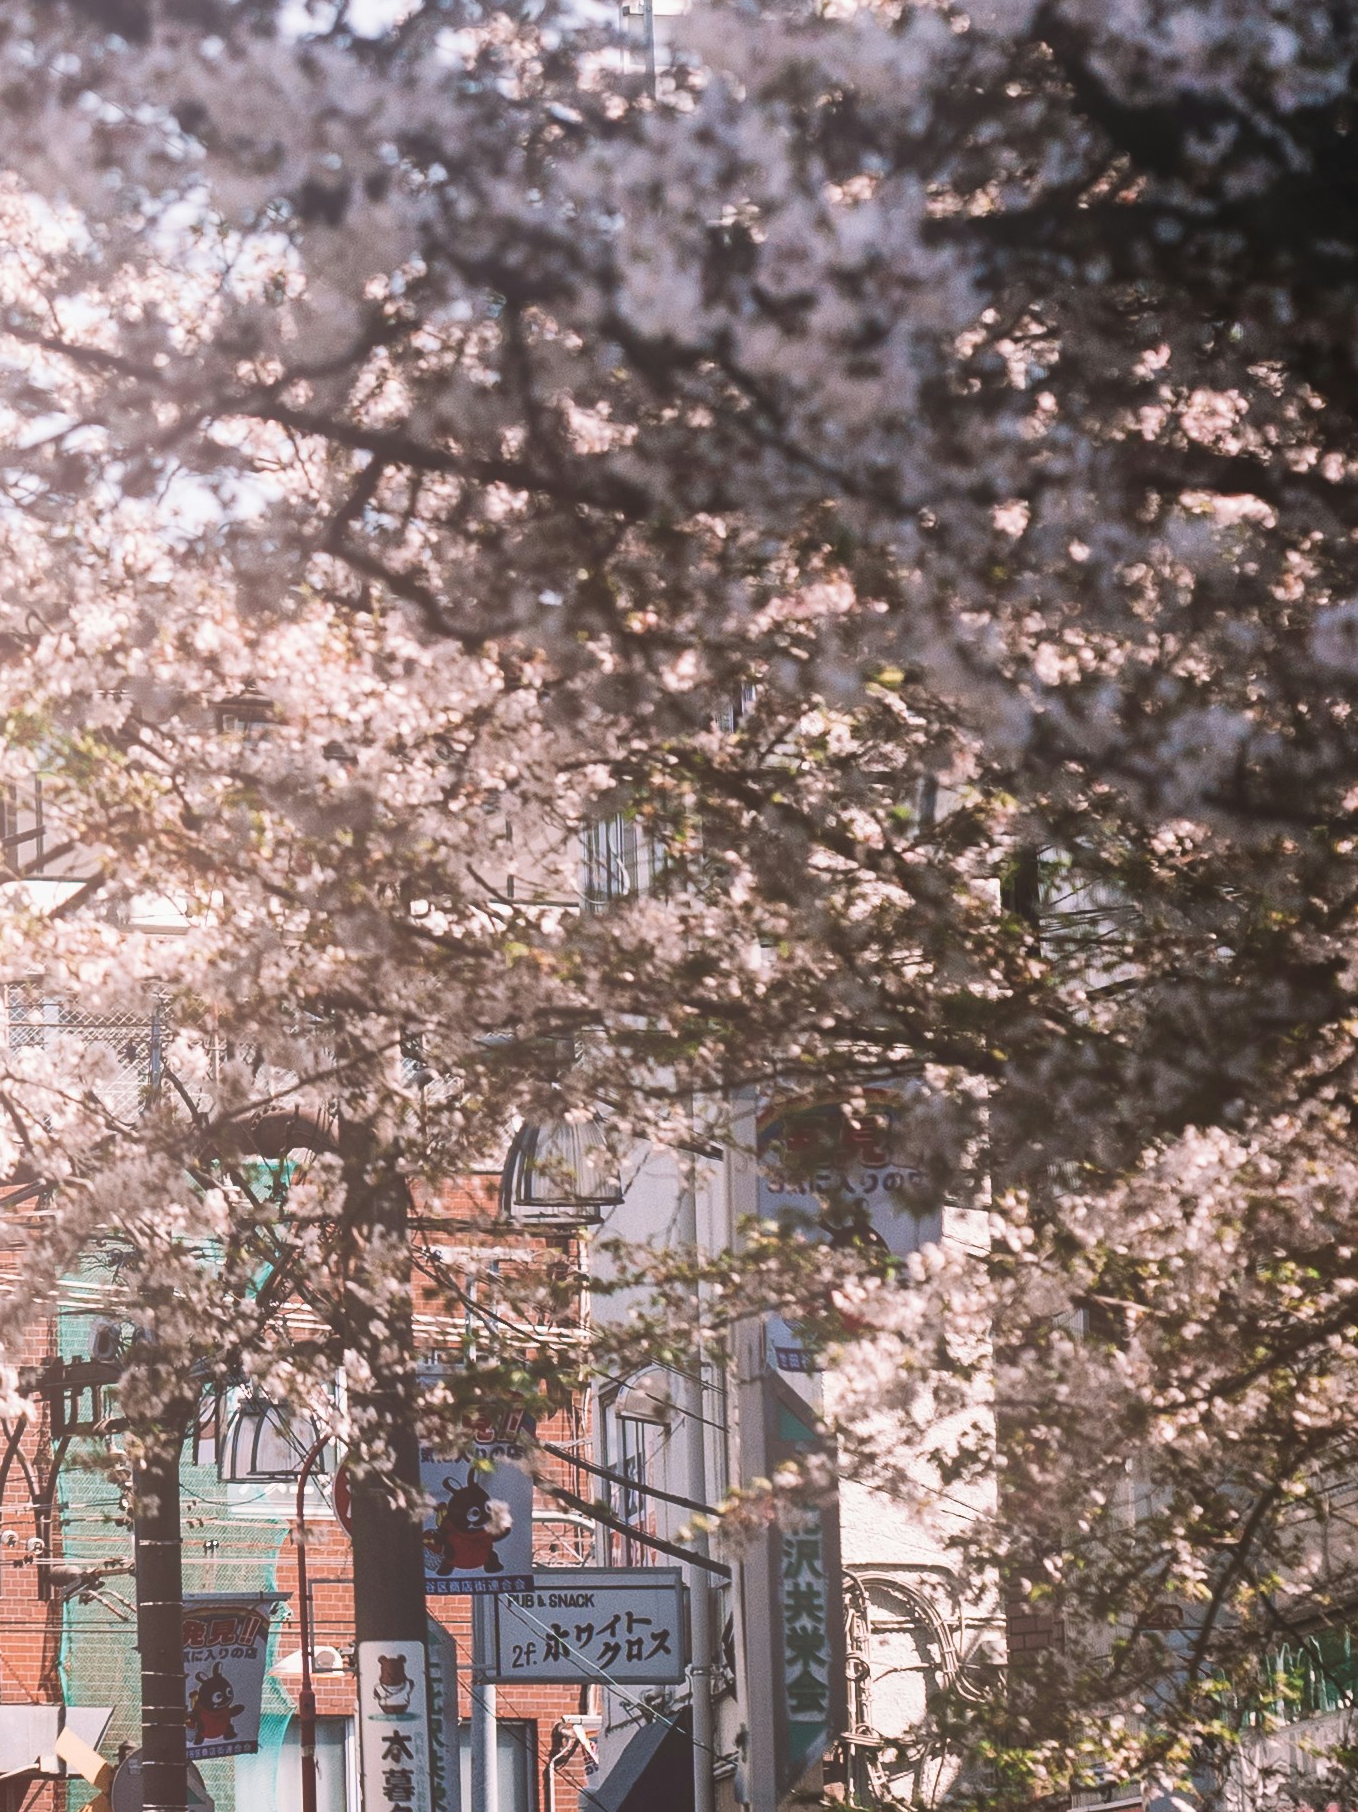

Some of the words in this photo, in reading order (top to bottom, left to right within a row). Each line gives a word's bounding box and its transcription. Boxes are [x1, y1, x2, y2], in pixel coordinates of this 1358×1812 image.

[507, 1594, 533, 1608] PUB
[537, 1595, 546, 1607] &
[549, 1594, 595, 1608] SNACK
[543, 1611, 652, 1663] ホワイト
[595, 1629, 671, 1670] クロス
